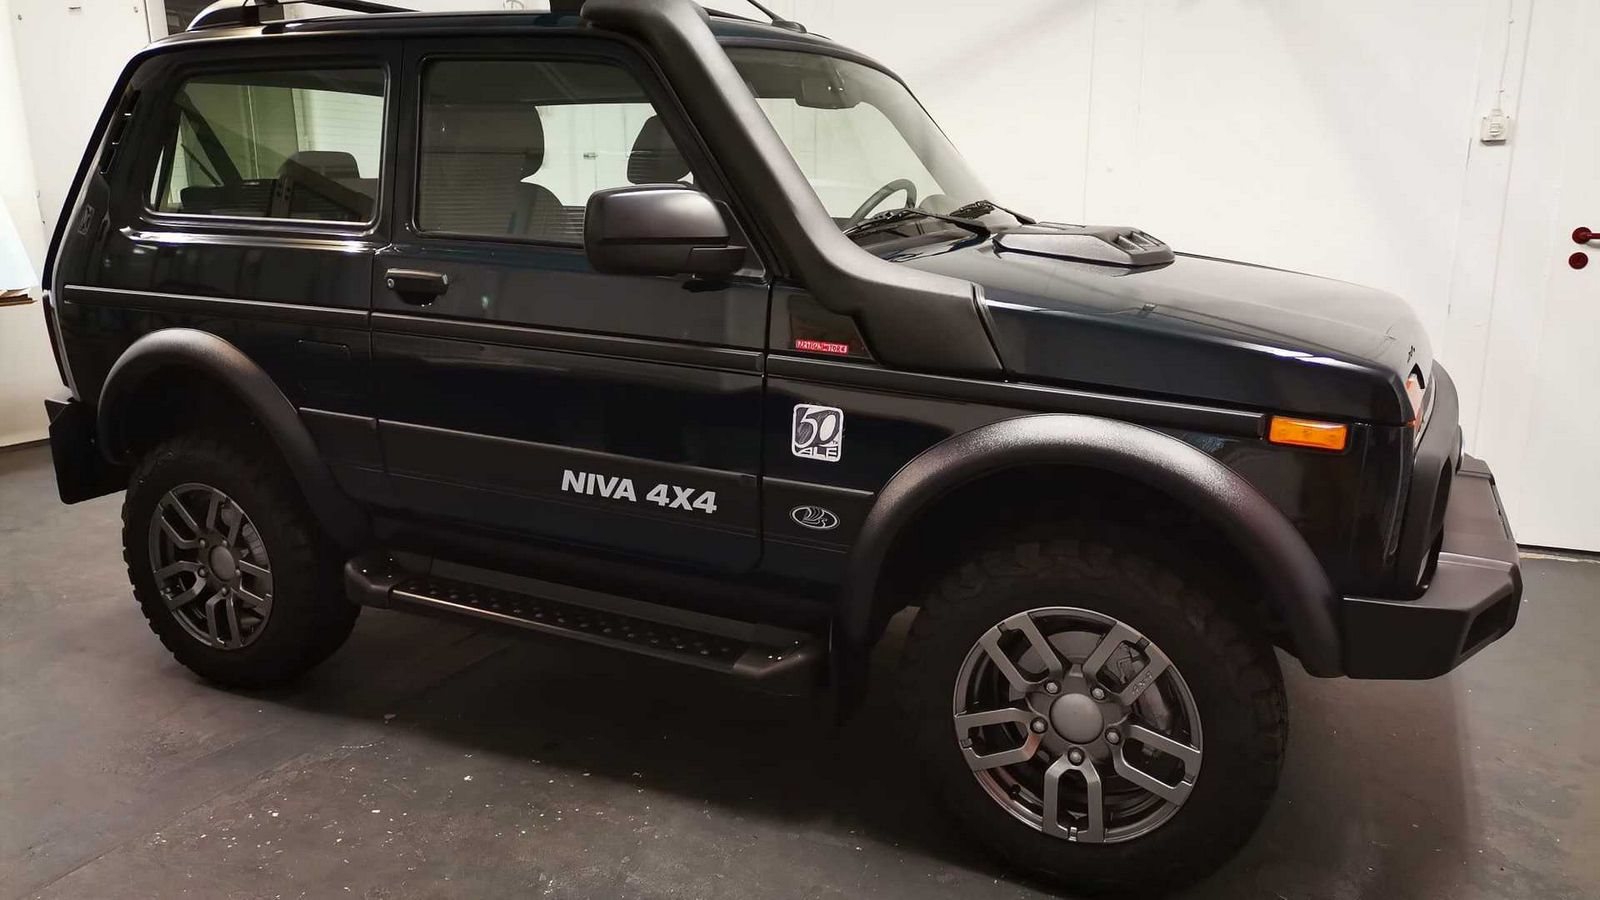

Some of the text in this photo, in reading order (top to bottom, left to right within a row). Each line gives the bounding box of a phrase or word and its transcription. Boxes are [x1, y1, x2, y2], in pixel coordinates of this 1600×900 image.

[794, 406, 840, 447] 50
[561, 469, 718, 514] NIVA 4X4
